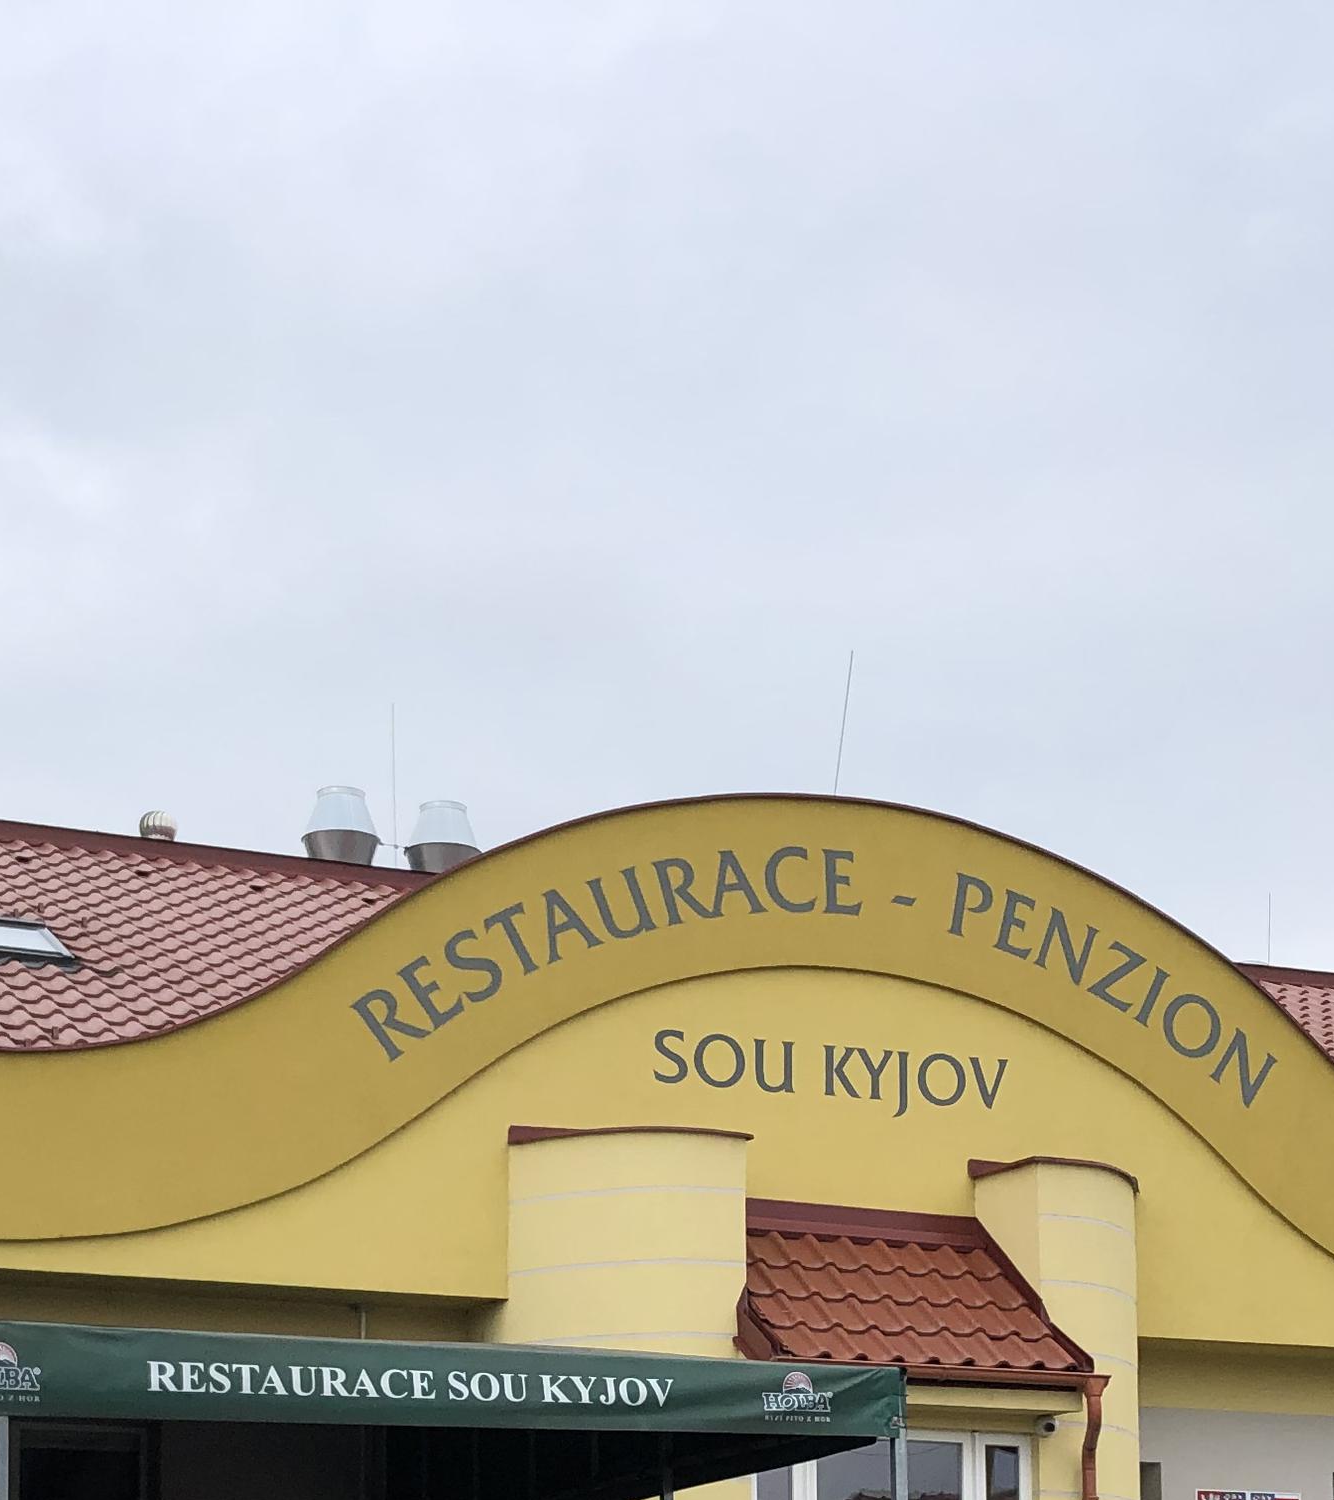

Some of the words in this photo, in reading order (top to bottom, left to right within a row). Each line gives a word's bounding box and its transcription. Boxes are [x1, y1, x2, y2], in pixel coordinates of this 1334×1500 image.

[349, 846, 863, 1062] RESTAURACE
[948, 872, 1278, 1109] PENZION
[653, 1029, 794, 1093] SOU
[823, 1045, 1009, 1117] KYJOV
[147, 1361, 436, 1399] RESTAURACE
[448, 1371, 528, 1402] SOU
[541, 1374, 674, 1407] KYJOV
[762, 1392, 831, 1412] HOLBA
